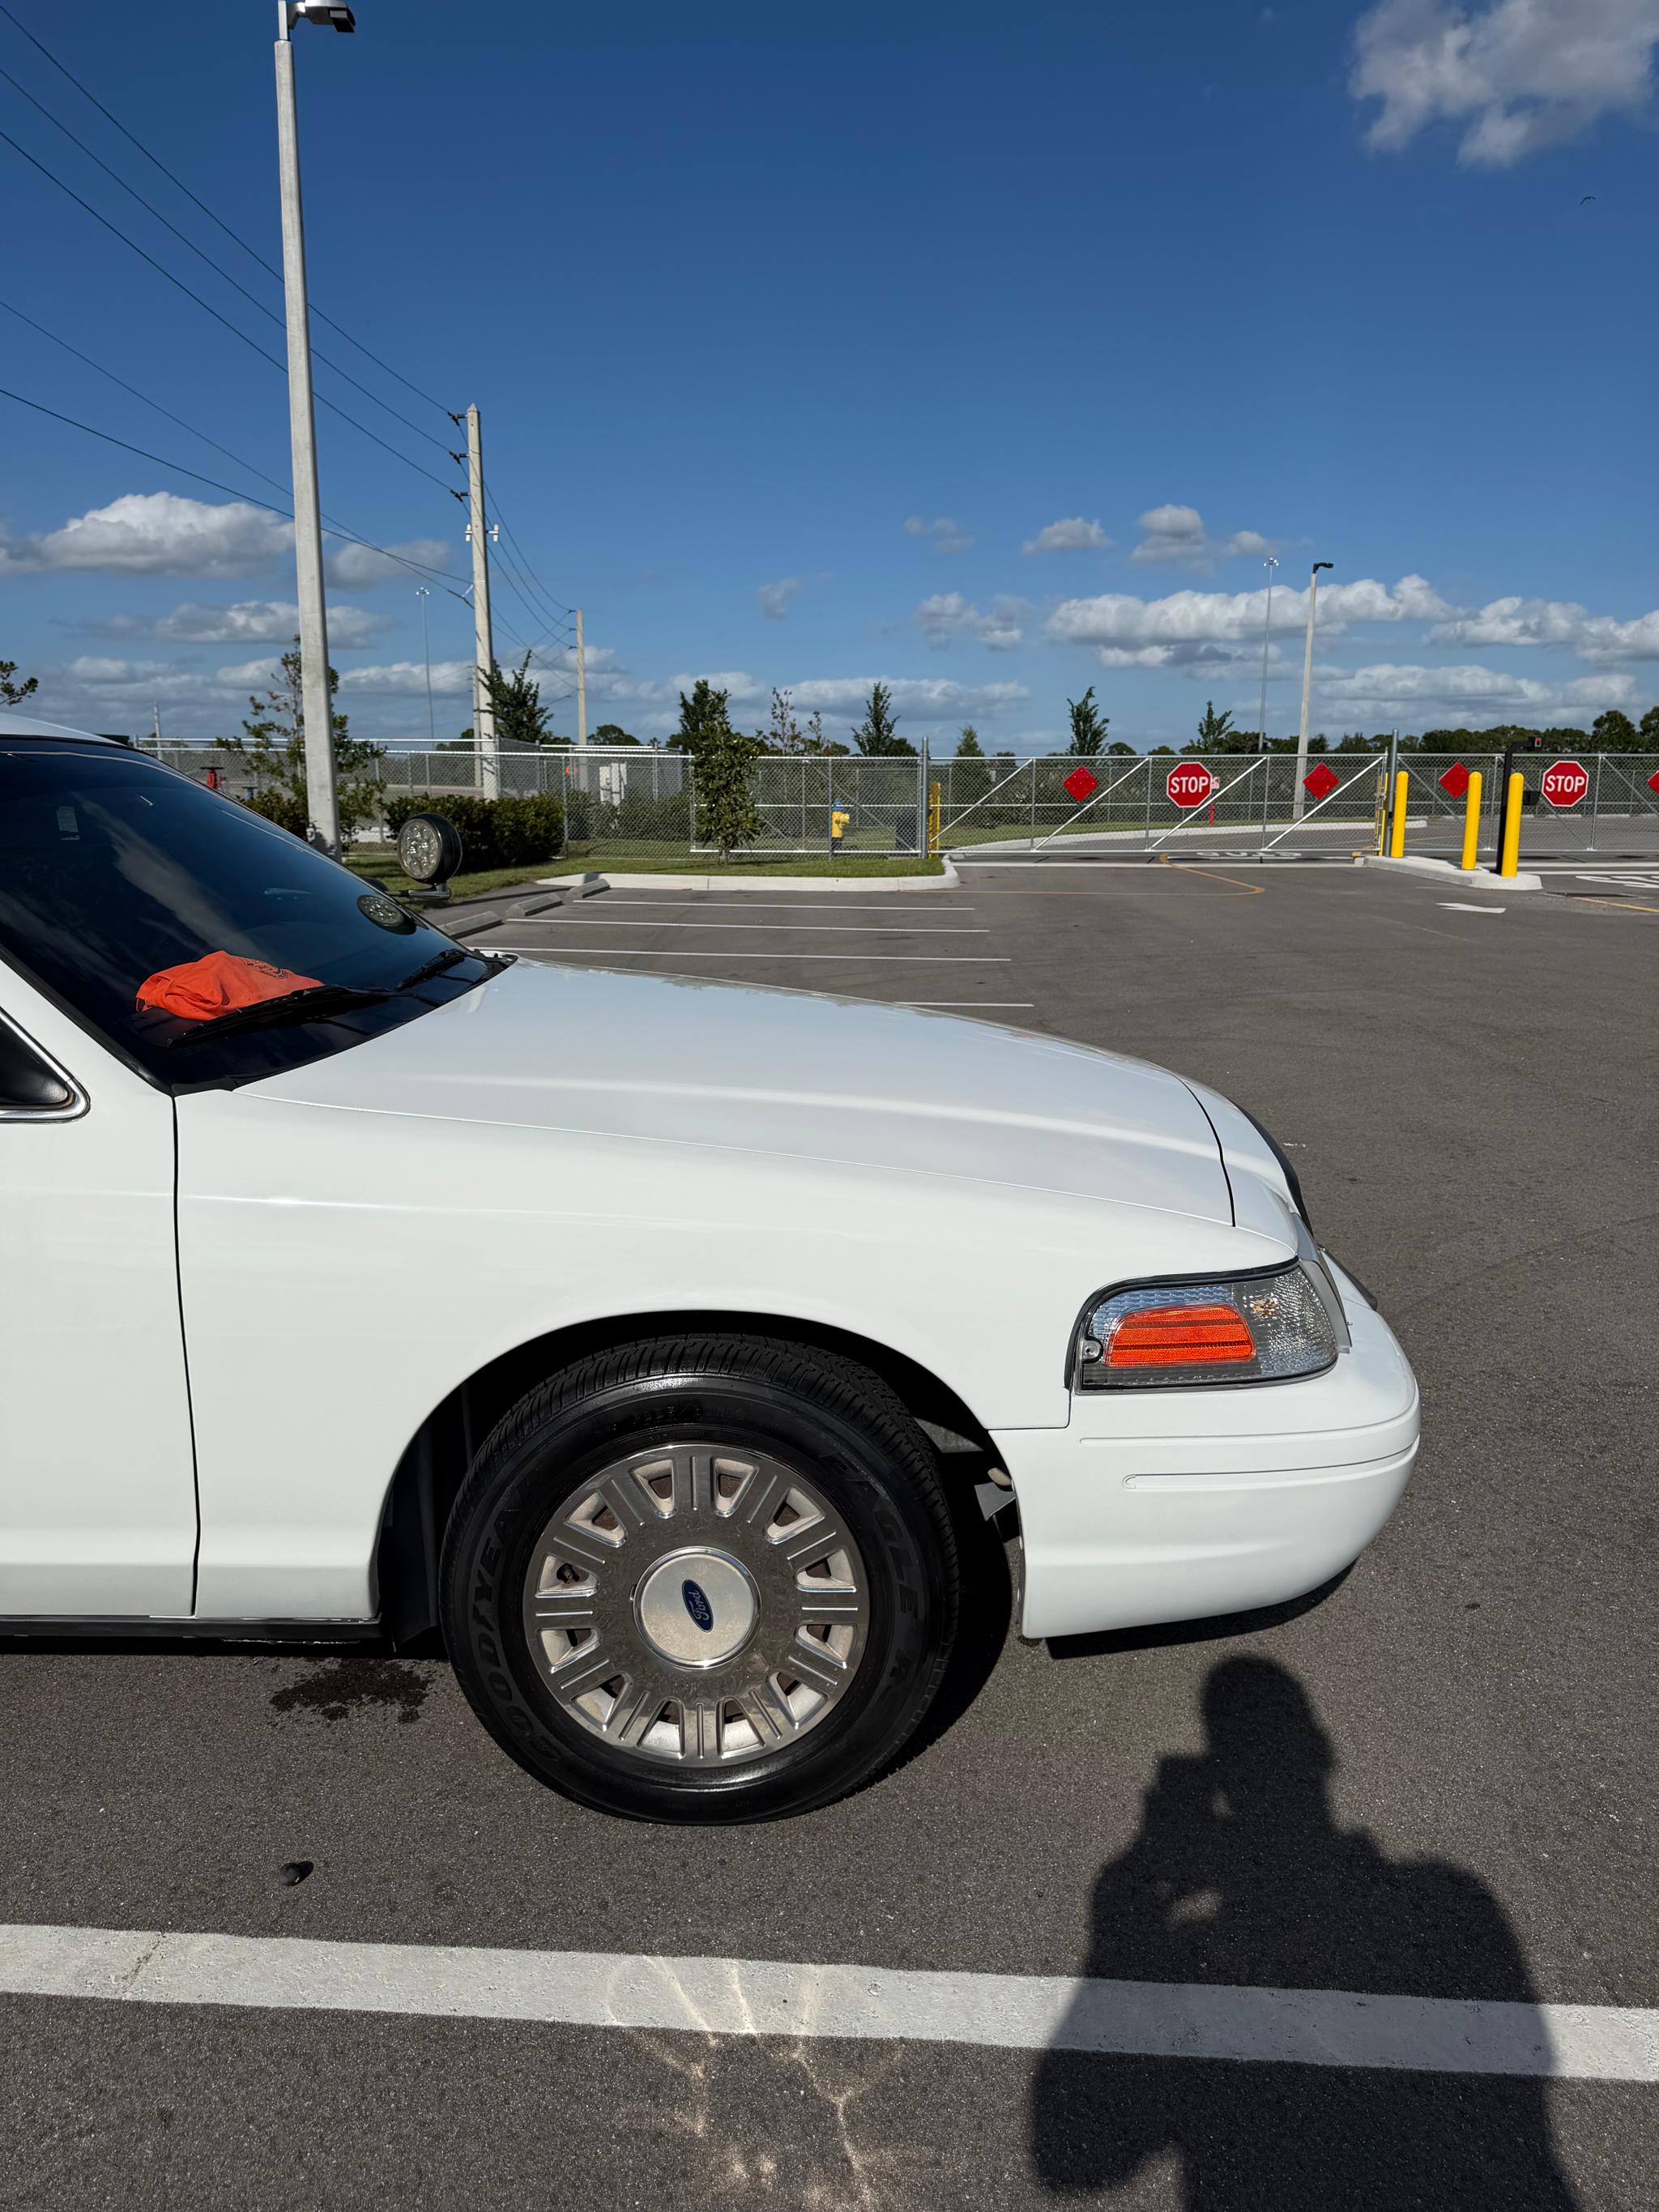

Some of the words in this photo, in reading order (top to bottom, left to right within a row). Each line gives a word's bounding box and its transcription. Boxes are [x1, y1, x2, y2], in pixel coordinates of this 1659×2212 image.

[1170, 776, 1209, 794] STOP
[1545, 775, 1585, 793] STOP
[688, 1590, 710, 1620] Ford
